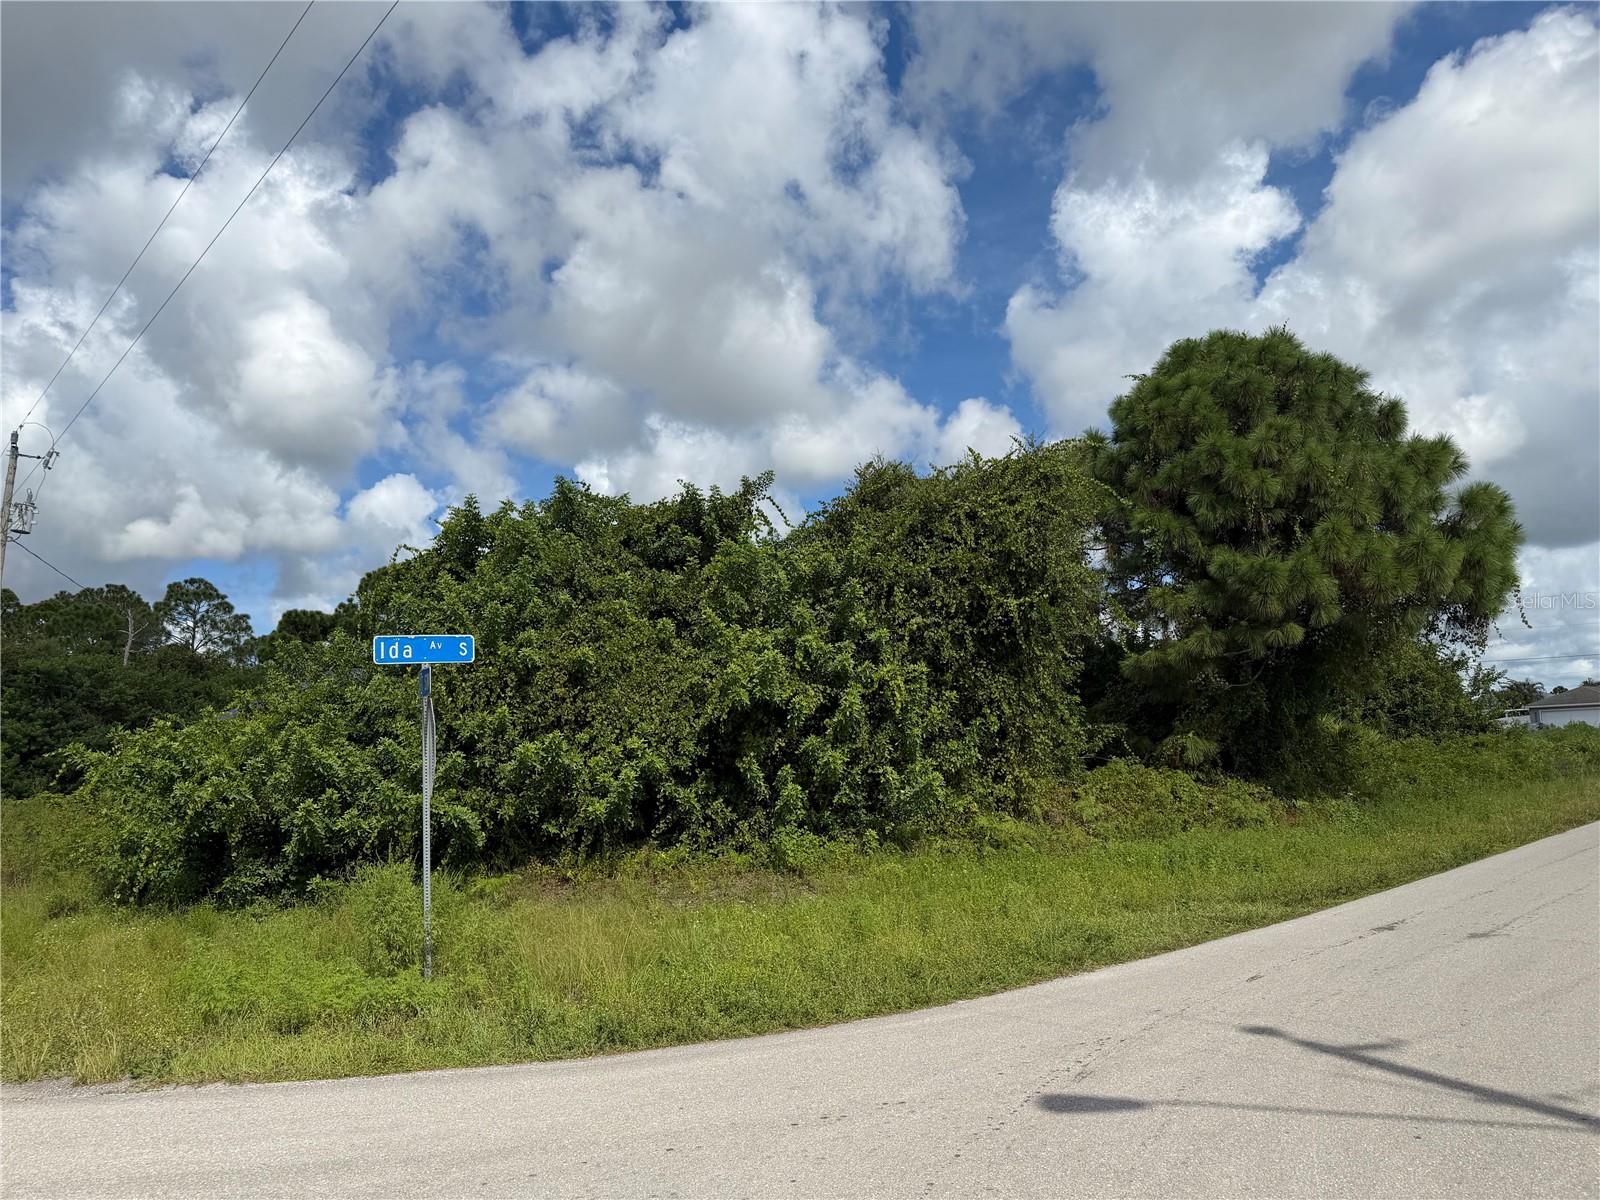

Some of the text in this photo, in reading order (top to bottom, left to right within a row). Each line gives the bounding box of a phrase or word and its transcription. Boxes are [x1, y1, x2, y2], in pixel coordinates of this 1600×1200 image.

[380, 641, 468, 659] Ida Av S
